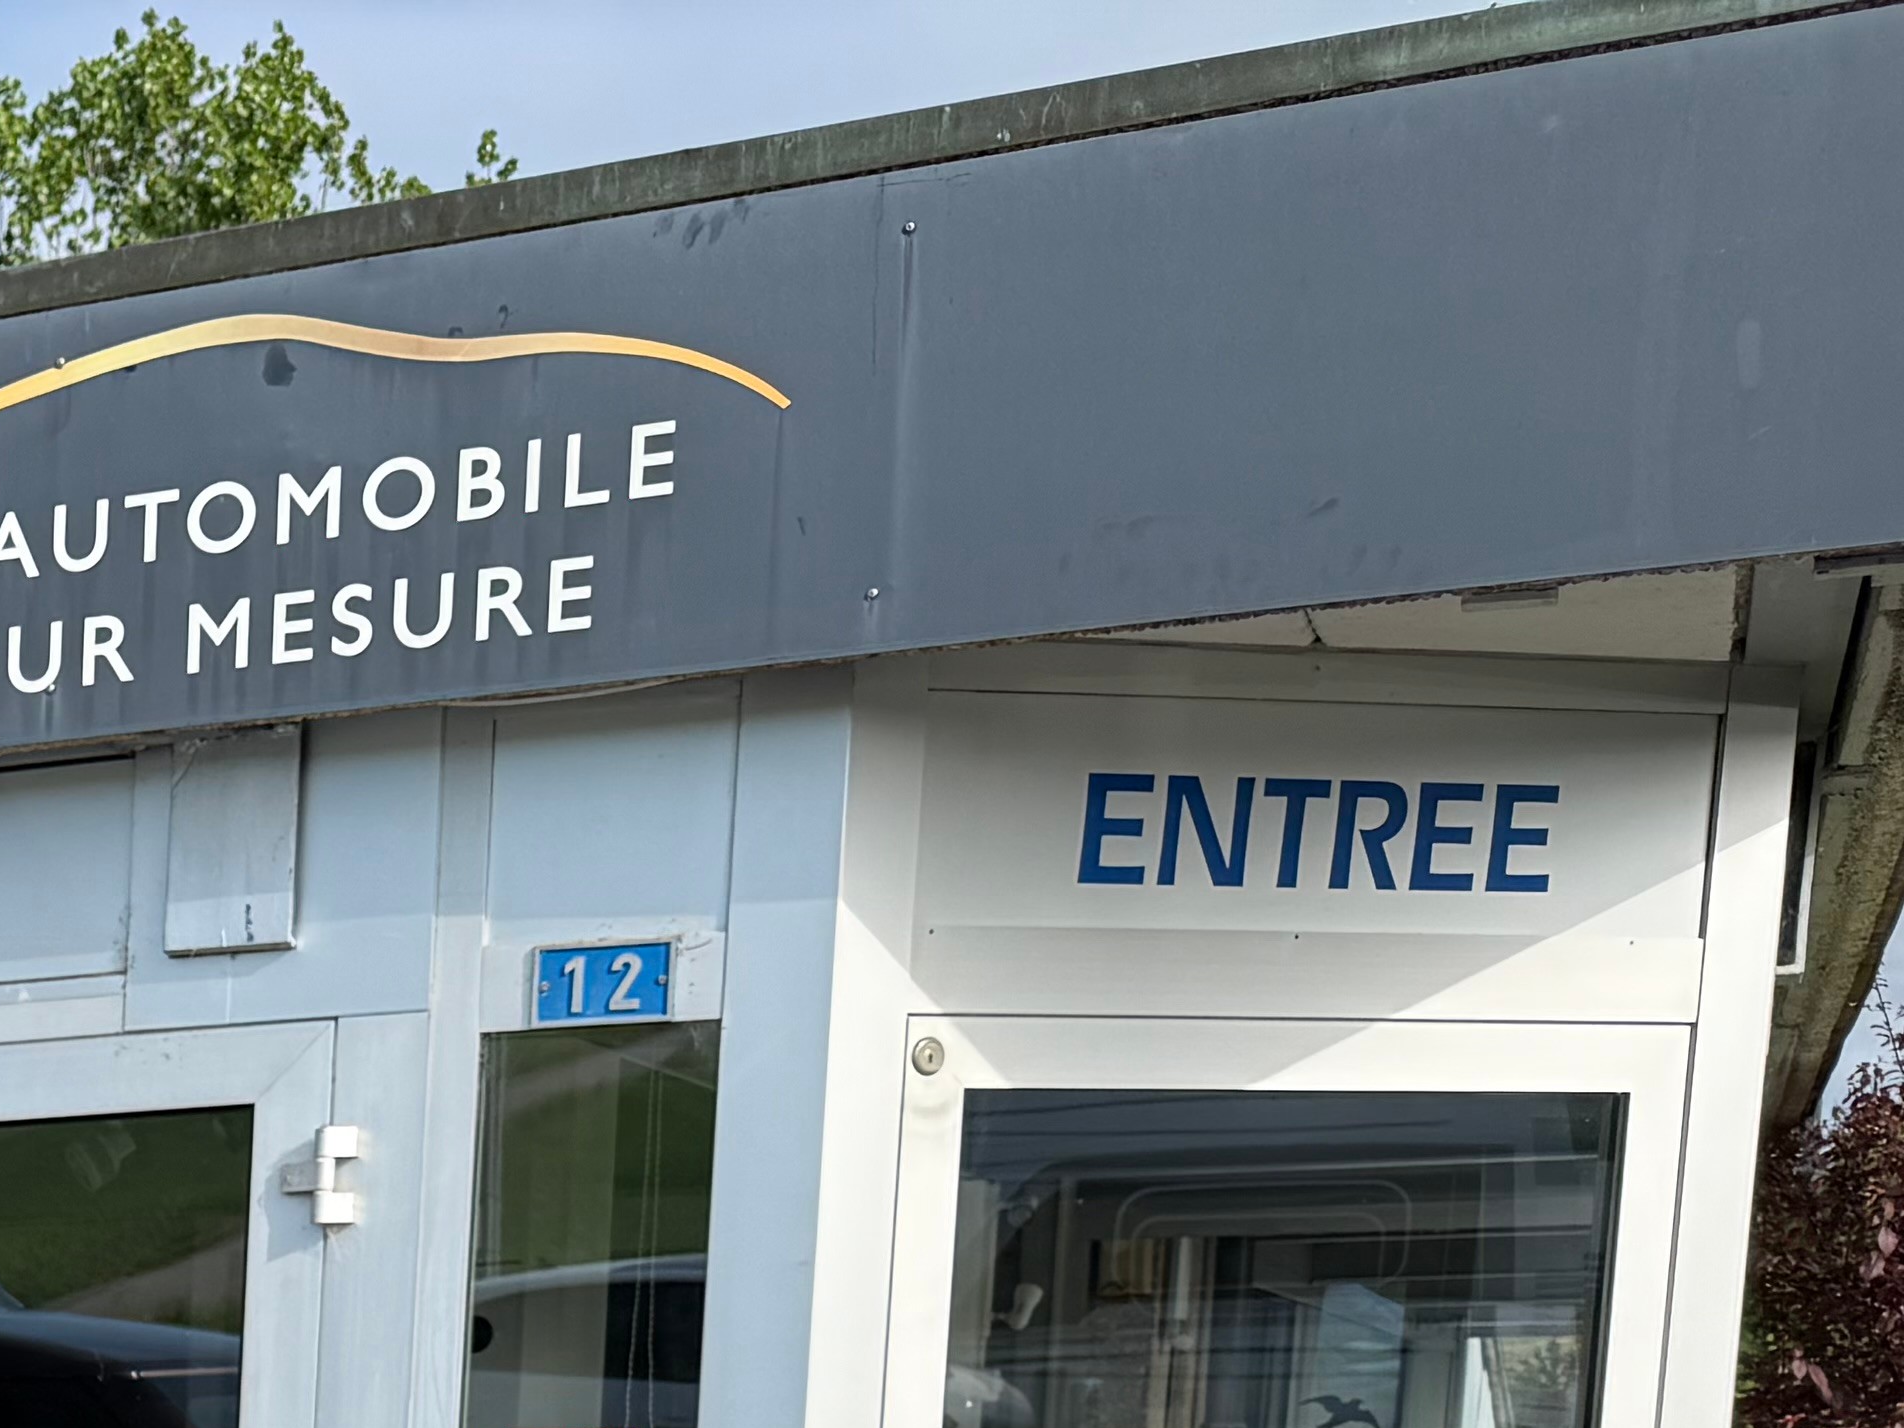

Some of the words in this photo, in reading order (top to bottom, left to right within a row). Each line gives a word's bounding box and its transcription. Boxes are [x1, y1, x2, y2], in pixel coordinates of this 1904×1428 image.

[185, 554, 595, 676] MESURE
[1077, 772, 1561, 893] ENTREE
[563, 952, 645, 1014] 12
